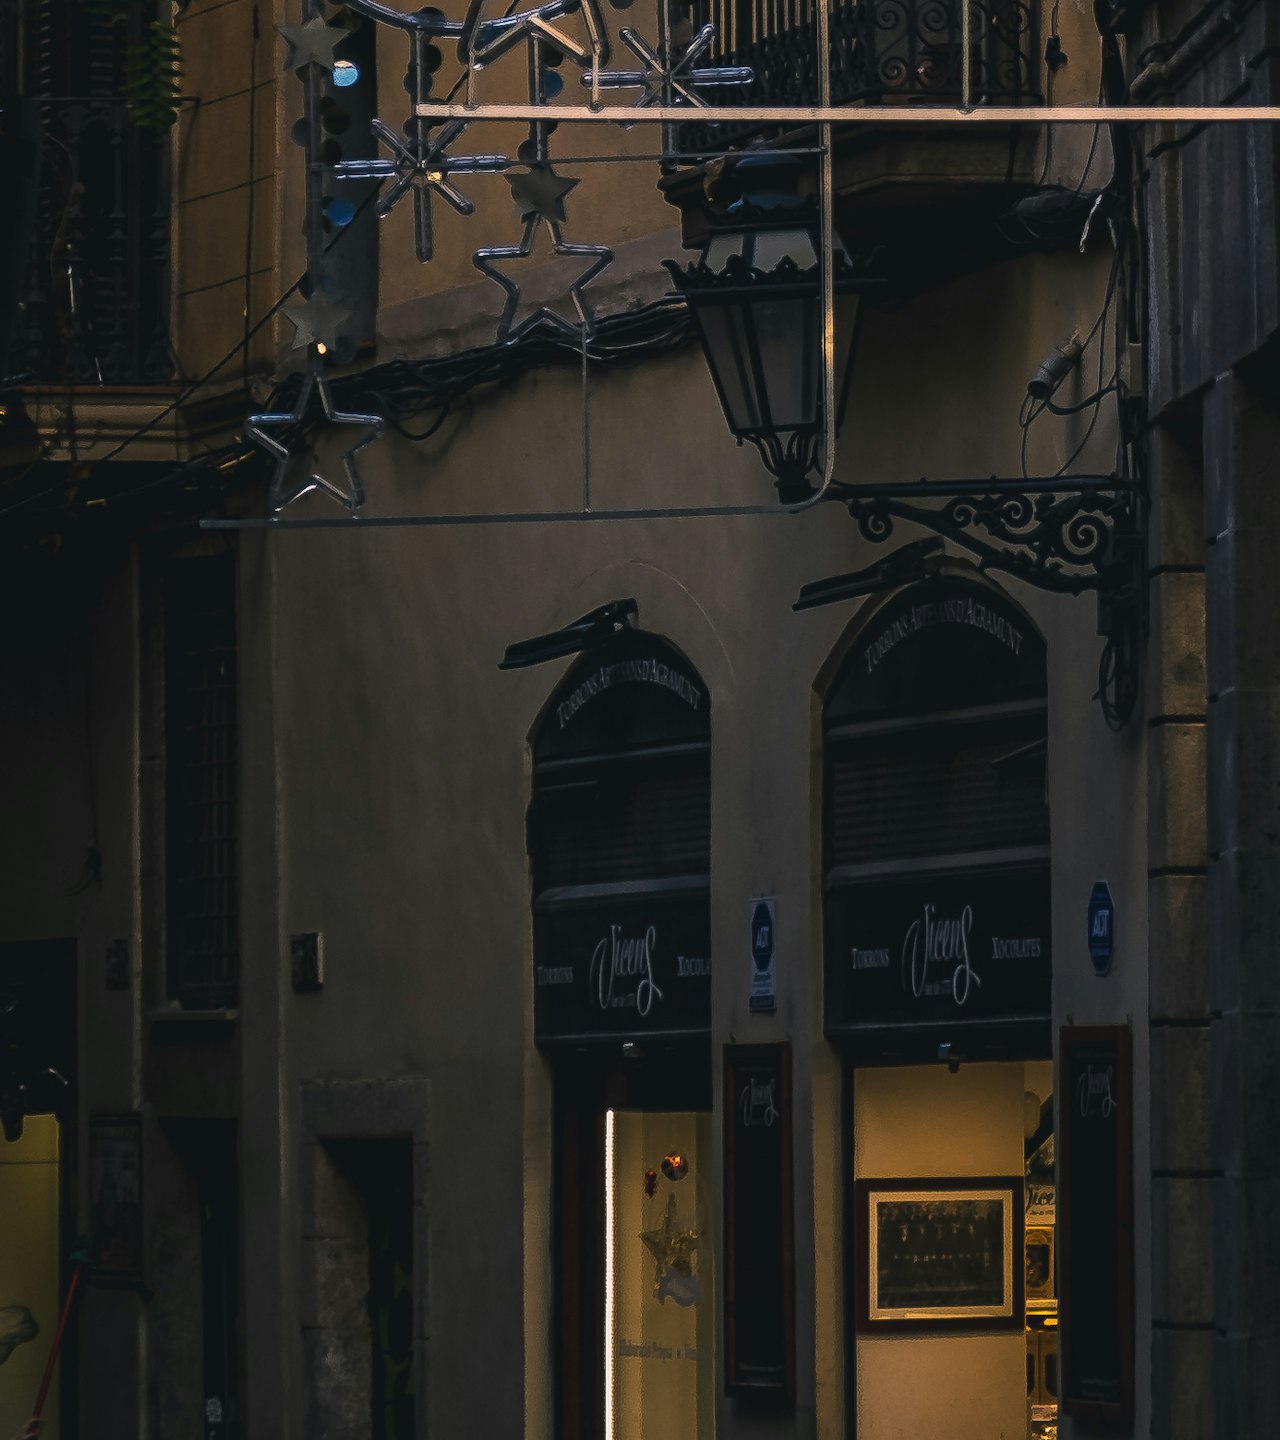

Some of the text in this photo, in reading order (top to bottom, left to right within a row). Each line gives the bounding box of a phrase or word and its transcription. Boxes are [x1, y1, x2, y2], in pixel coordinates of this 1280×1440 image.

[1092, 909, 1110, 937] ADT
[851, 947, 890, 969] TORRONS
[991, 936, 1041, 960] XOCOLATES
[536, 965, 575, 986] TORRONS
